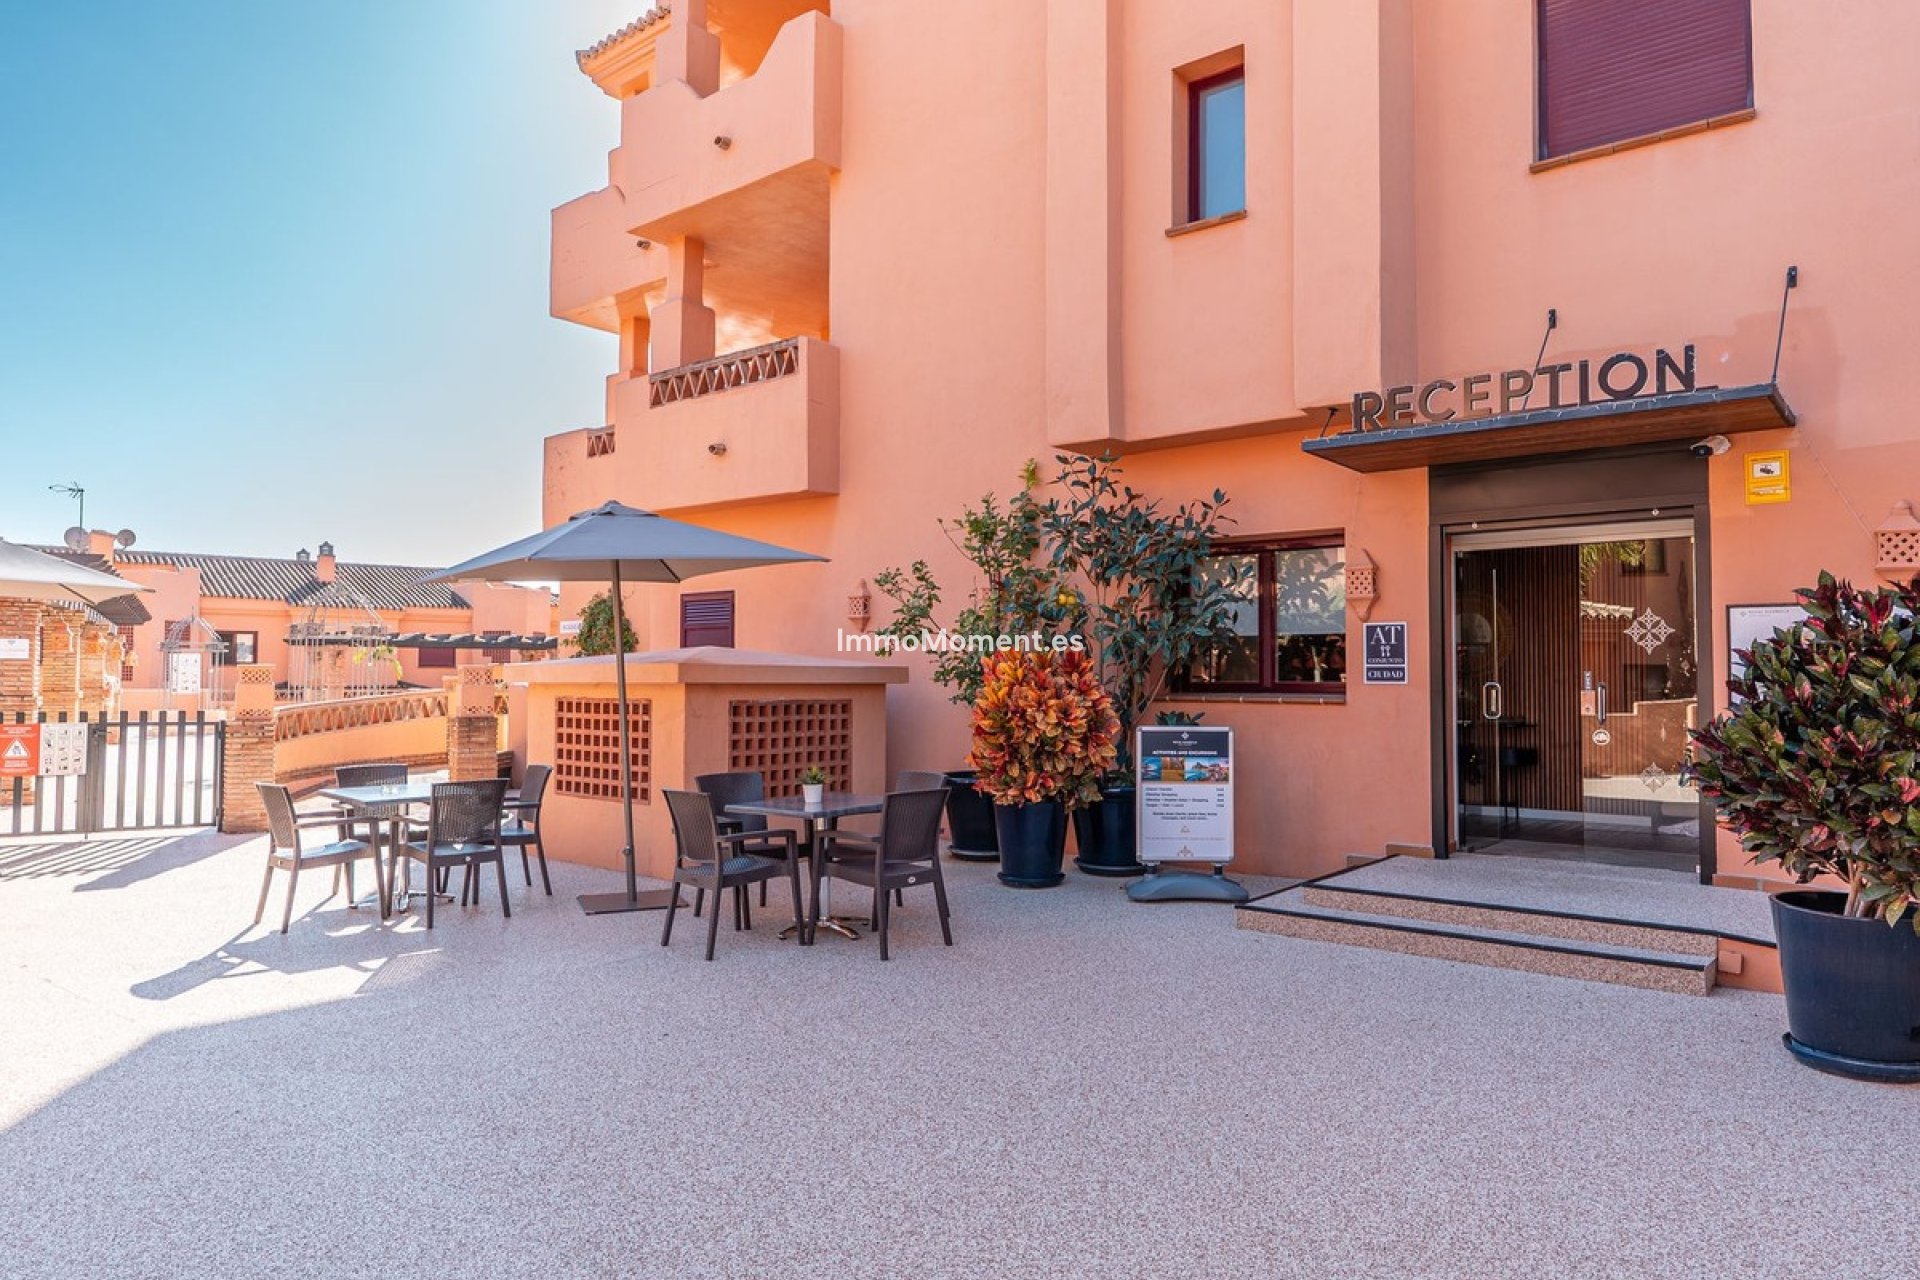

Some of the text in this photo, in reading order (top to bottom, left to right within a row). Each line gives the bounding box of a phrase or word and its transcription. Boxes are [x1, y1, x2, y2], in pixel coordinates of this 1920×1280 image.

[1353, 344, 1695, 433] RECEPTION
[1370, 626, 1401, 644] AT
[1368, 670, 1403, 678] CIUDAD
